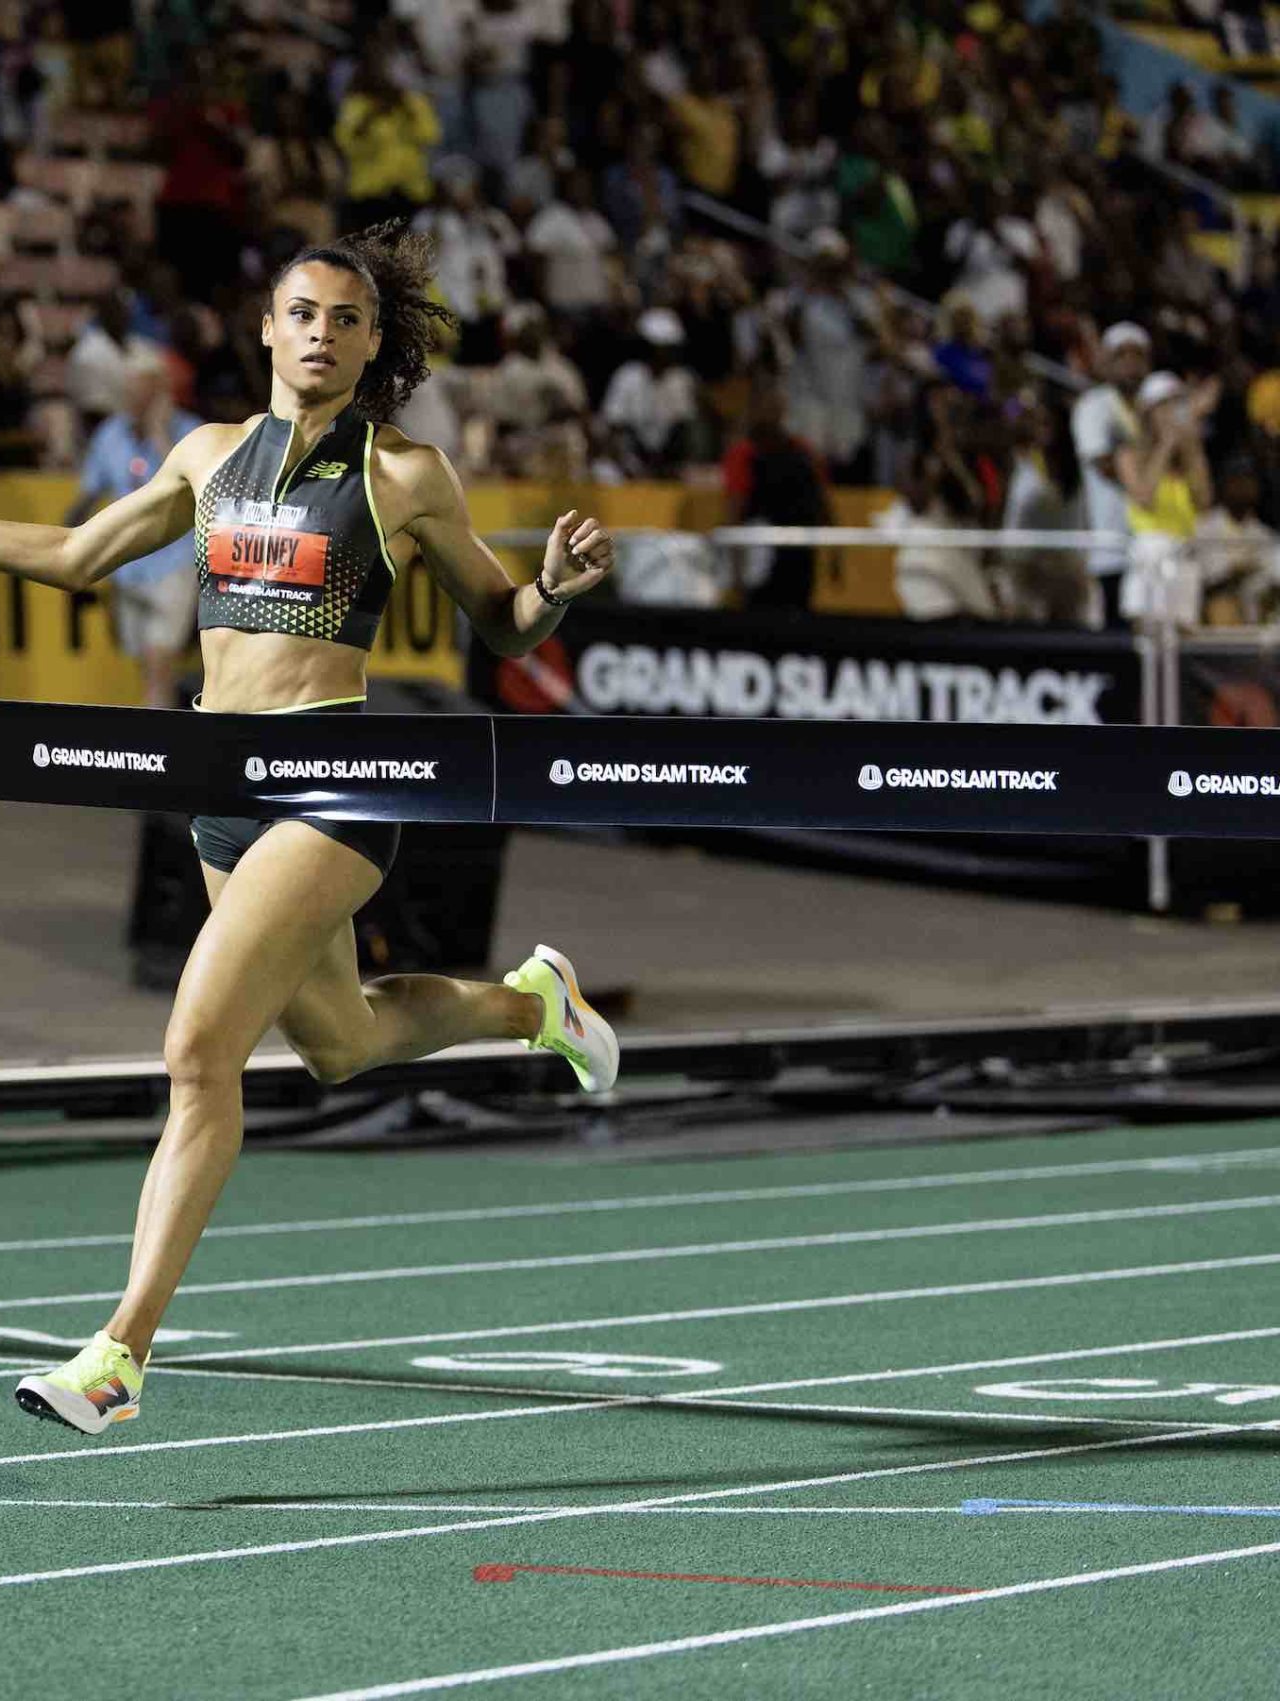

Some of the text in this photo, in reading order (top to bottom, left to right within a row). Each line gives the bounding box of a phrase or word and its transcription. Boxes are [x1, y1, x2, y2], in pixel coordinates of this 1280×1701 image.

[231, 531, 299, 568] SYDNEY
[280, 589, 313, 601] TRACK
[578, 641, 1106, 724] GRAND SLAM TRACK
[51, 748, 166, 772] GRAND SLAM TRACK
[270, 760, 436, 780] GRAND SLAM TRACK
[577, 763, 747, 784] GRAND SLAM TRACK
[886, 768, 1056, 790] GRAND SLAM TRACK
[1195, 775, 1280, 796] GRAND SL
